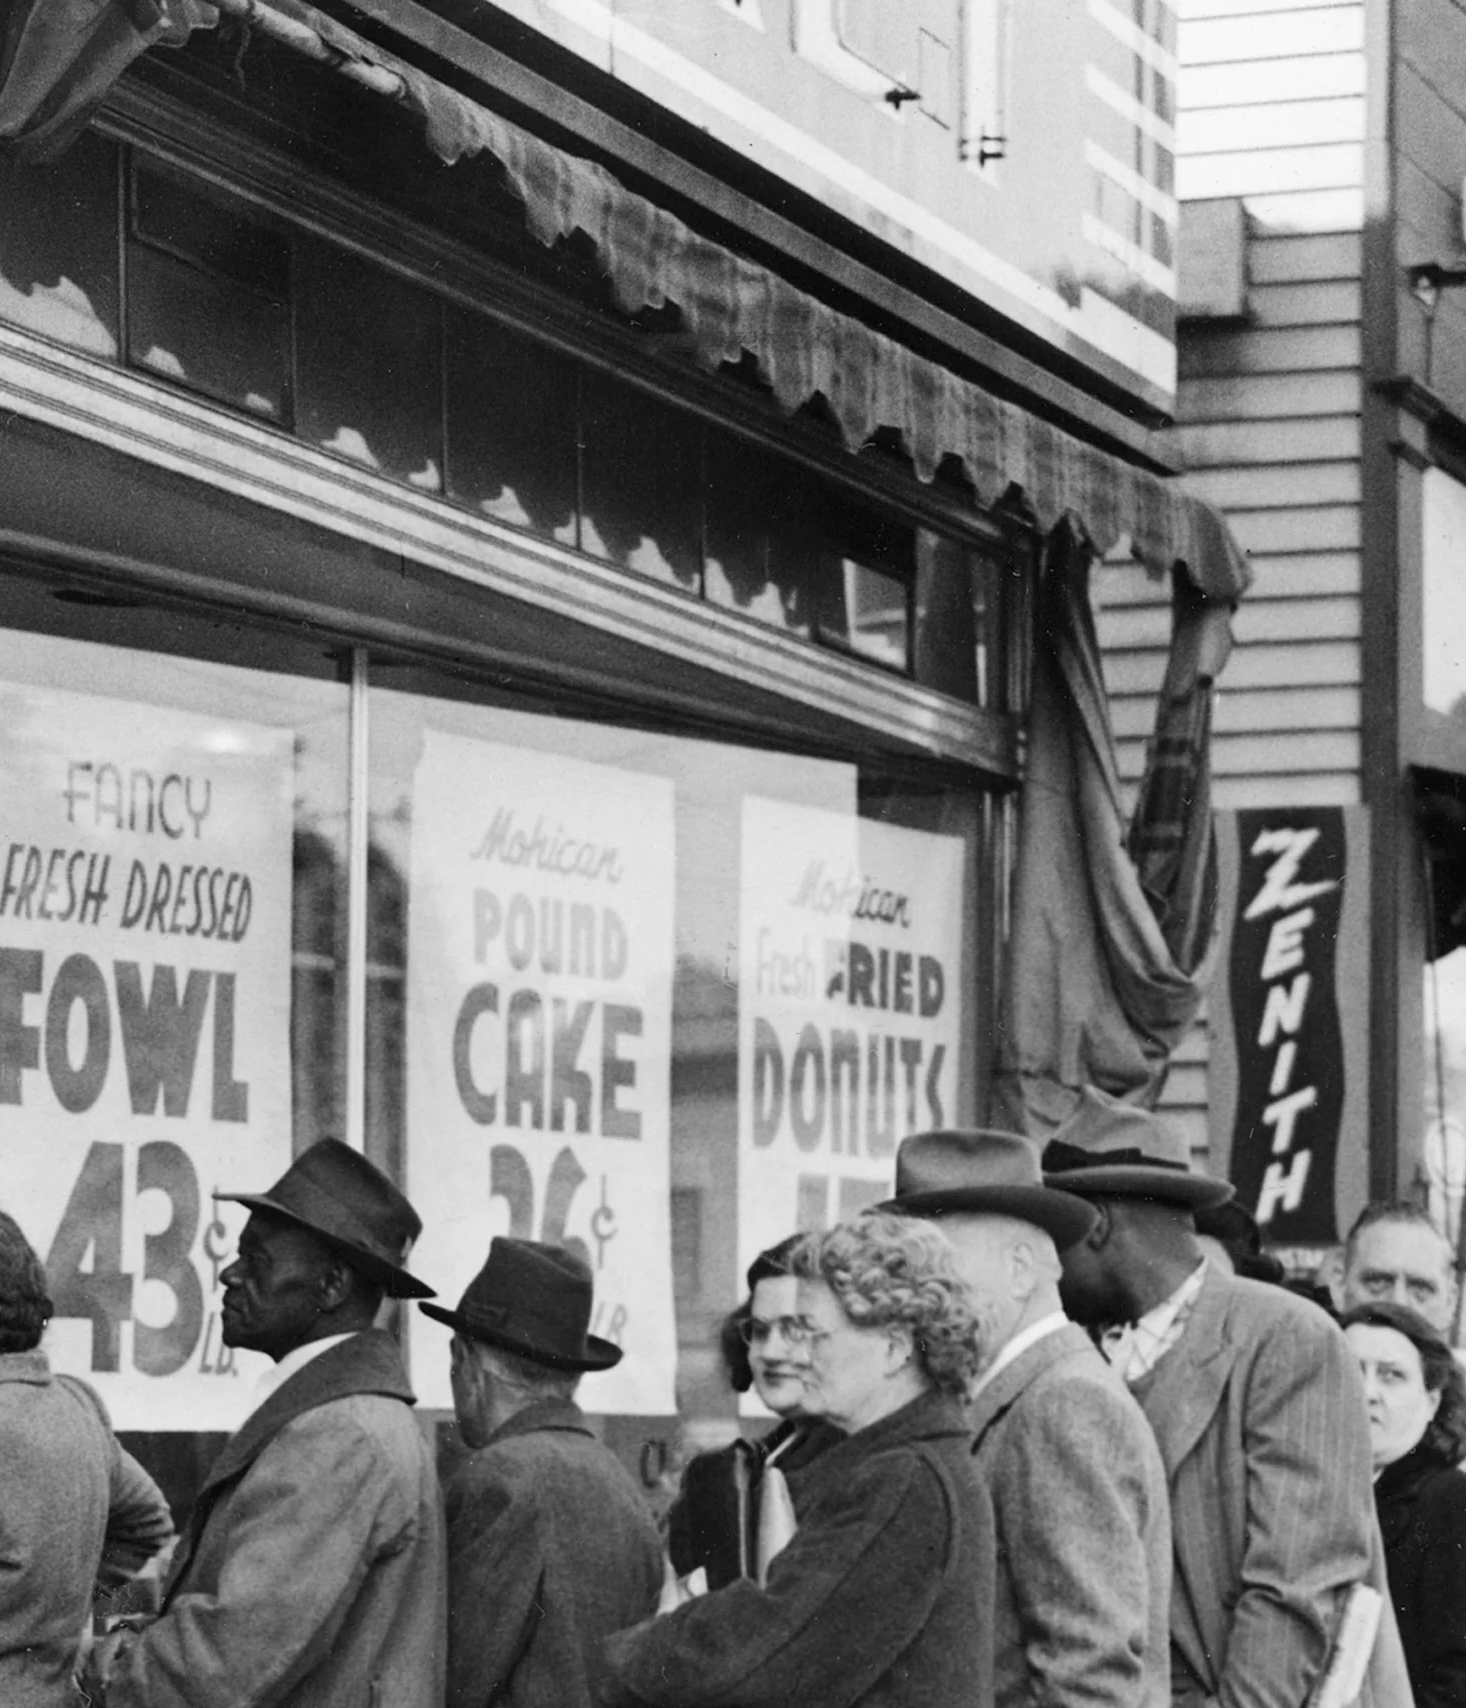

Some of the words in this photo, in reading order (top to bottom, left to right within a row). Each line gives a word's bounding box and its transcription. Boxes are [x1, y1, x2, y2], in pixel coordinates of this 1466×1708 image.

[61, 760, 213, 841] FANCY
[470, 806, 624, 885] Mohican
[119, 859, 253, 943] DRESSED
[473, 887, 629, 981] POUND
[452, 982, 644, 1142] CAKE
[1245, 827, 1337, 1224] ZENITH
